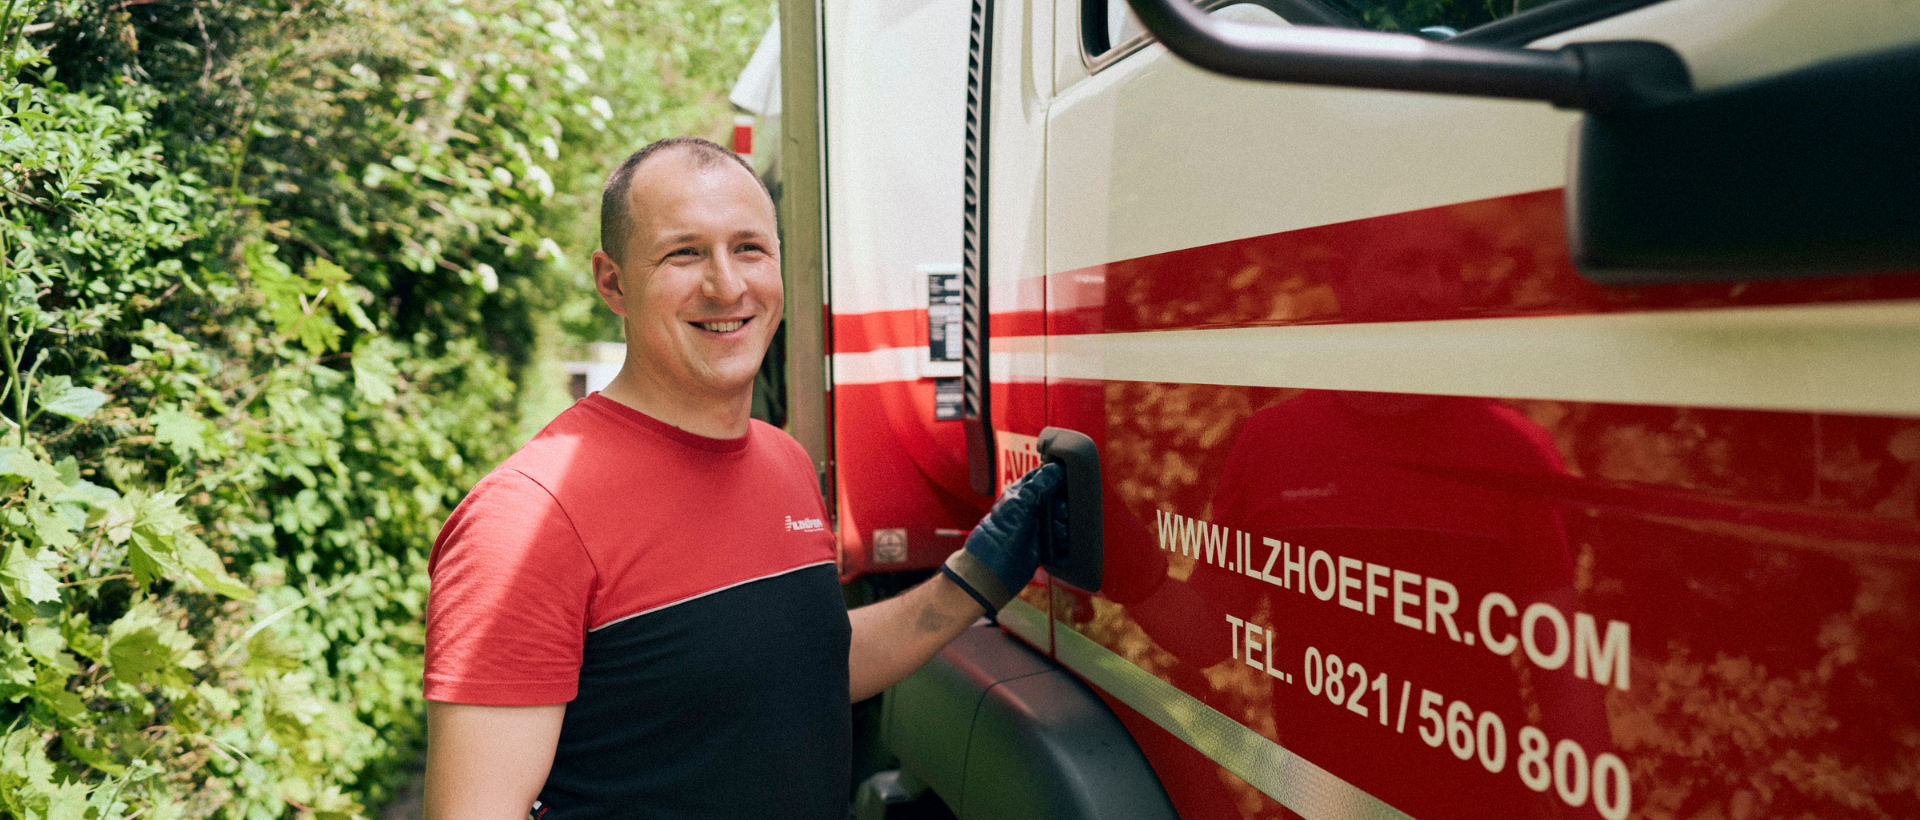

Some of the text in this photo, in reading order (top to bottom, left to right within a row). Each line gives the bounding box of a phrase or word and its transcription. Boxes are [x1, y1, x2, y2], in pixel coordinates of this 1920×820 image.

[1156, 509, 1630, 691] WWW.ILZHOEFER.COM
[1226, 614, 1292, 684] TEL.
[1418, 691, 1507, 773] 560
[1518, 726, 1631, 820] 800
